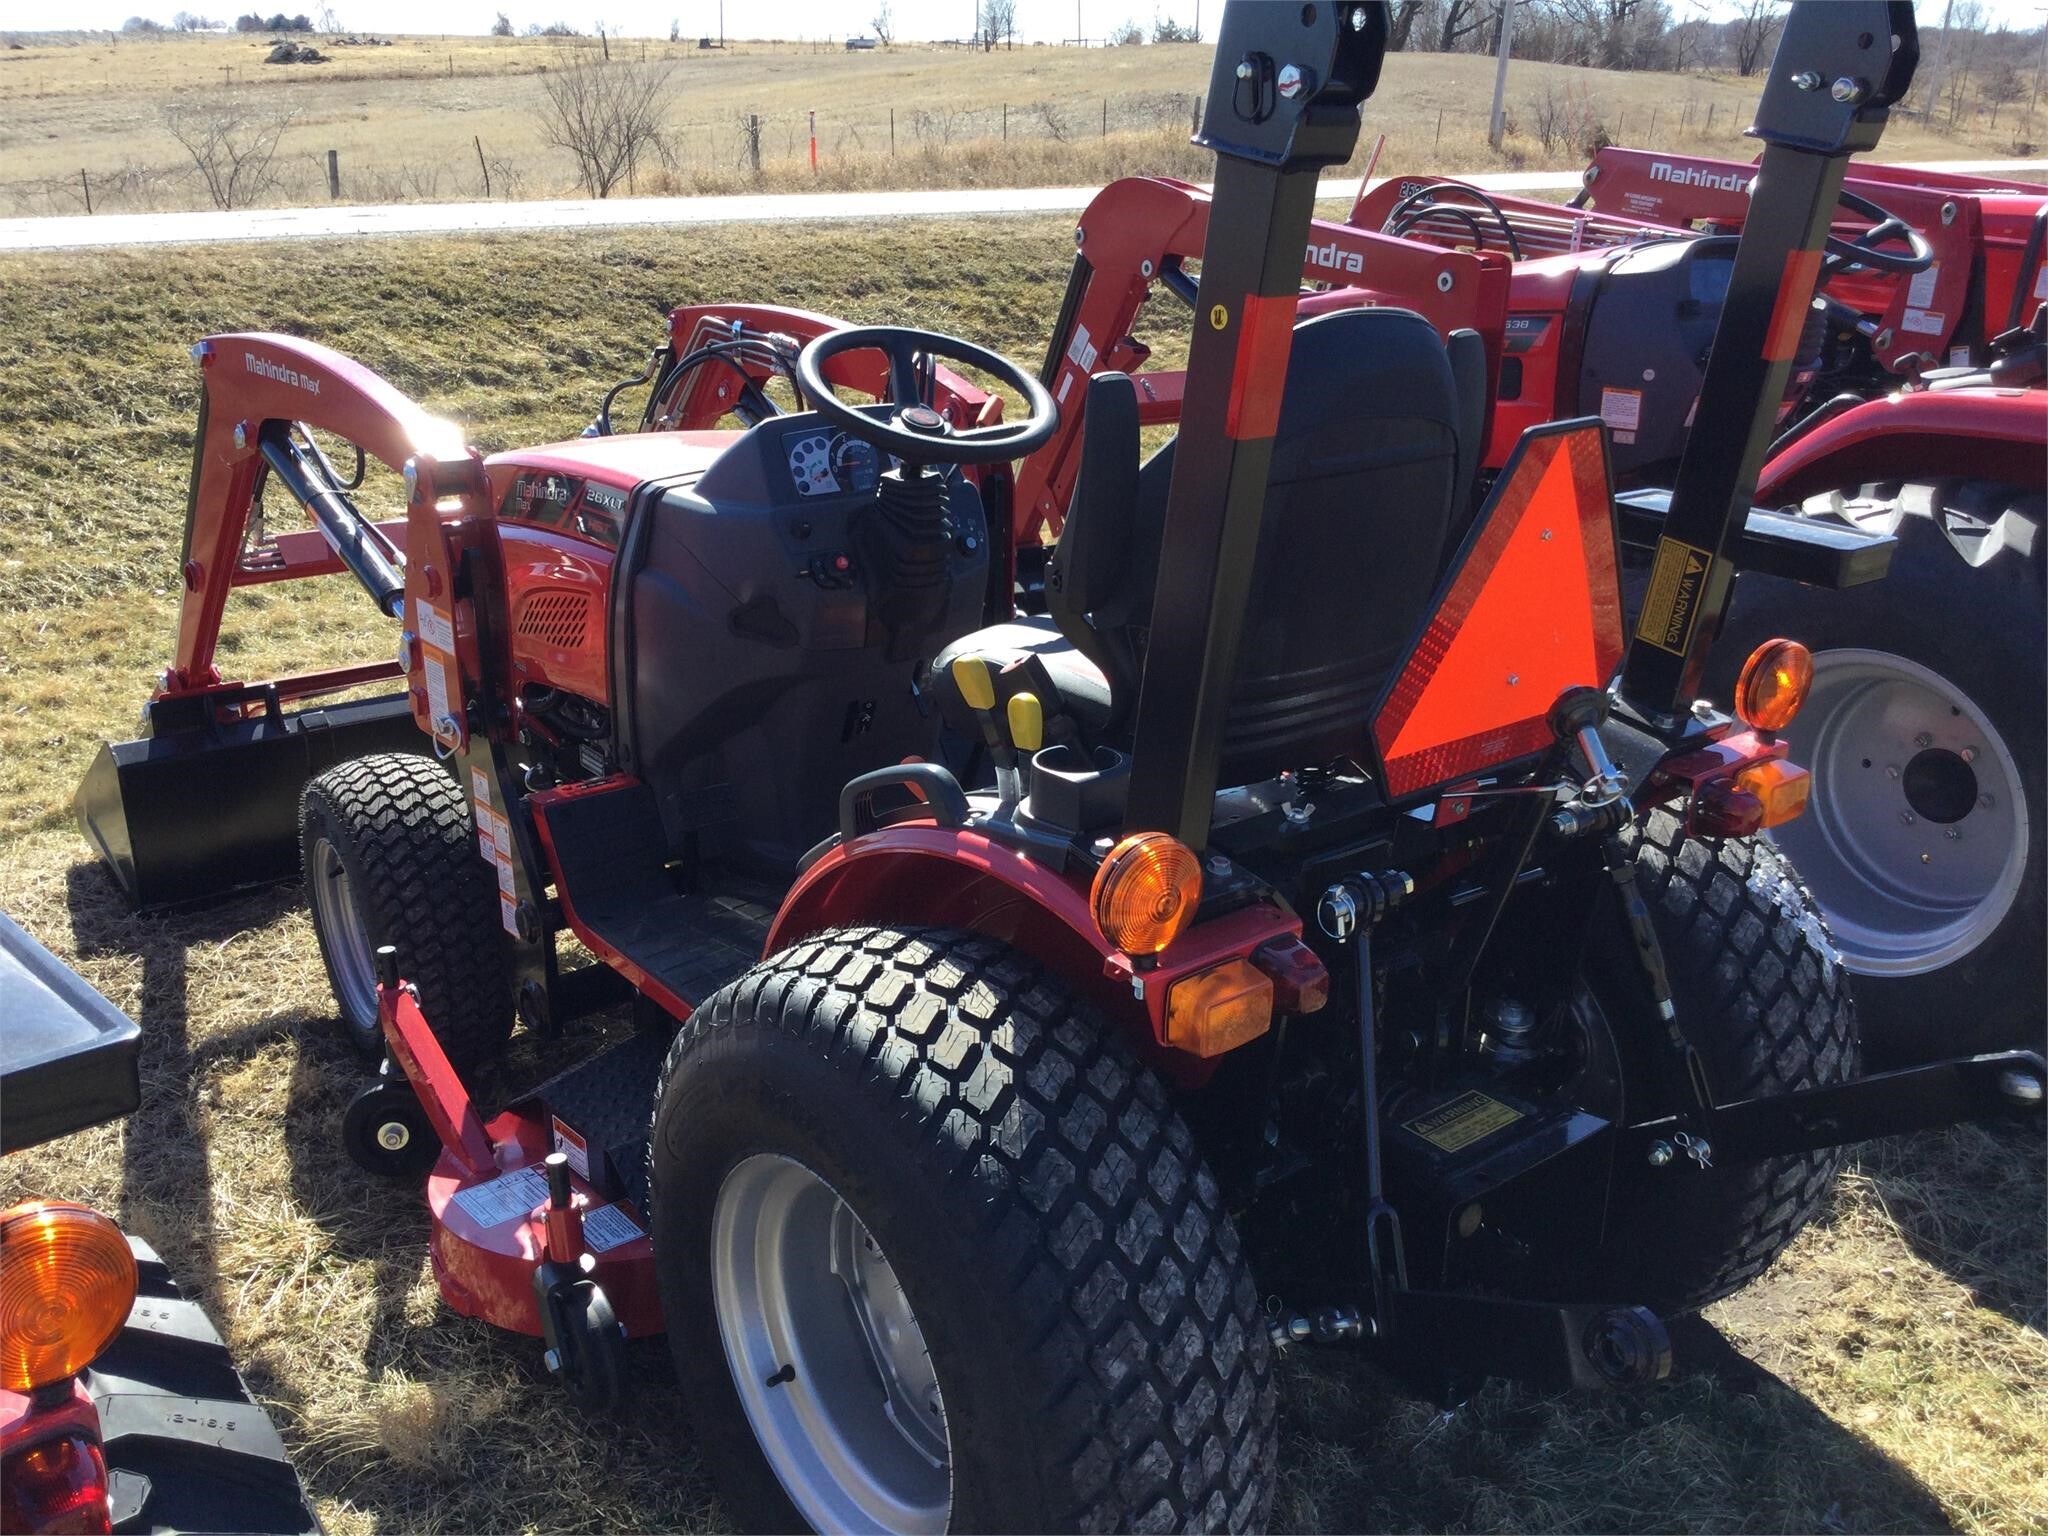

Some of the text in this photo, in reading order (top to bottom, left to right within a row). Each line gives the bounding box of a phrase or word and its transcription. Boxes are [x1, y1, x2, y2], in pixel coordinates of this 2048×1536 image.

[1650, 161, 1753, 195] Mahindr
[245, 352, 299, 387] Mahindra
[516, 480, 567, 503] Mahindra
[1666, 578, 1695, 645] WARNING
[1428, 1095, 1489, 1128] WARNING
